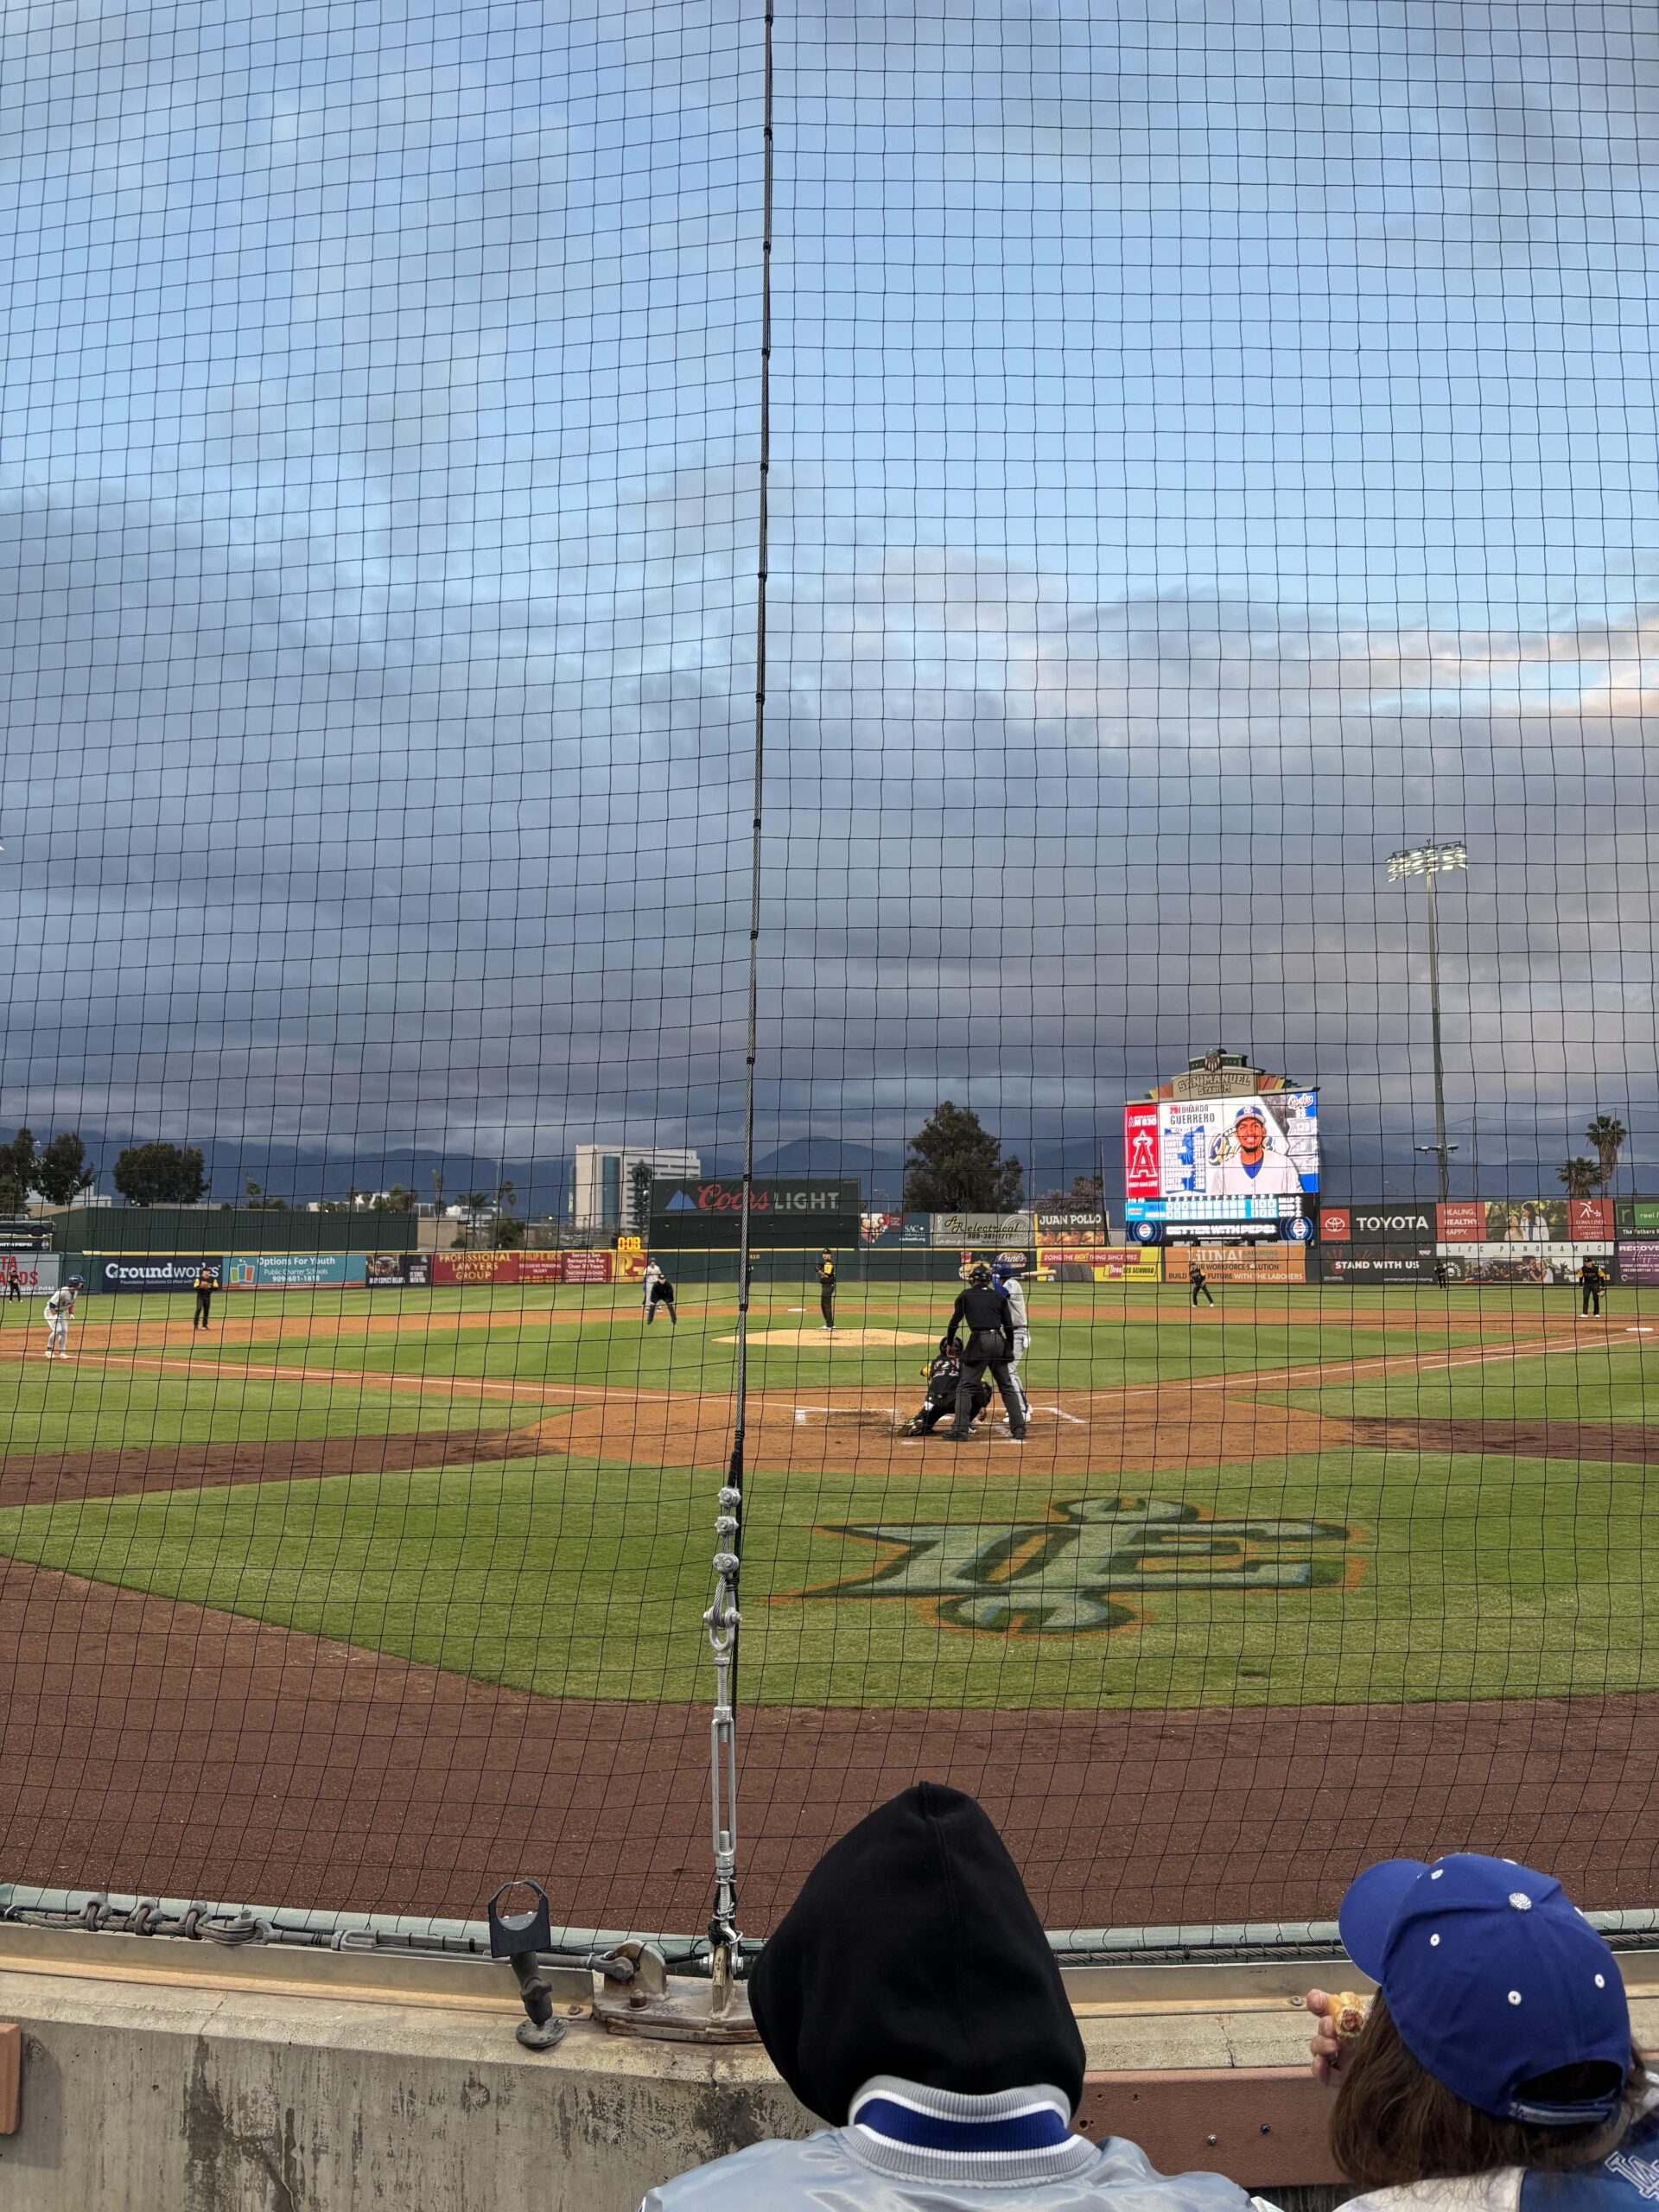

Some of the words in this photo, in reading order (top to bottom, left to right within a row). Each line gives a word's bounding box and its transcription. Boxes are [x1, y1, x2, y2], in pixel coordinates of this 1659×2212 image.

[1178, 1075, 1200, 1092] SAN
[1205, 1074, 1250, 1086] MANUEL
[1198, 1083, 1231, 1095] STADIUM
[1179, 1104, 1209, 1114] EDUARDO
[1171, 1113, 1215, 1125] GUERRERO
[697, 1184, 770, 1211] Coors
[774, 1192, 839, 1210] LIGHT
[1039, 1215, 1068, 1225] JUAN
[1070, 1214, 1102, 1224] POLLO
[1357, 1216, 1429, 1231] TOYOTA
[968, 1222, 1020, 1232] electrical
[257, 1257, 292, 1267] Options
[309, 1256, 335, 1265] Youth
[439, 1253, 512, 1262] PROFESSIONAL
[452, 1262, 499, 1271] LAWYERS
[1109, 1264, 1122, 1274] Tires
[1335, 1261, 1370, 1269] STAND
[455, 1271, 491, 1280] GROUP
